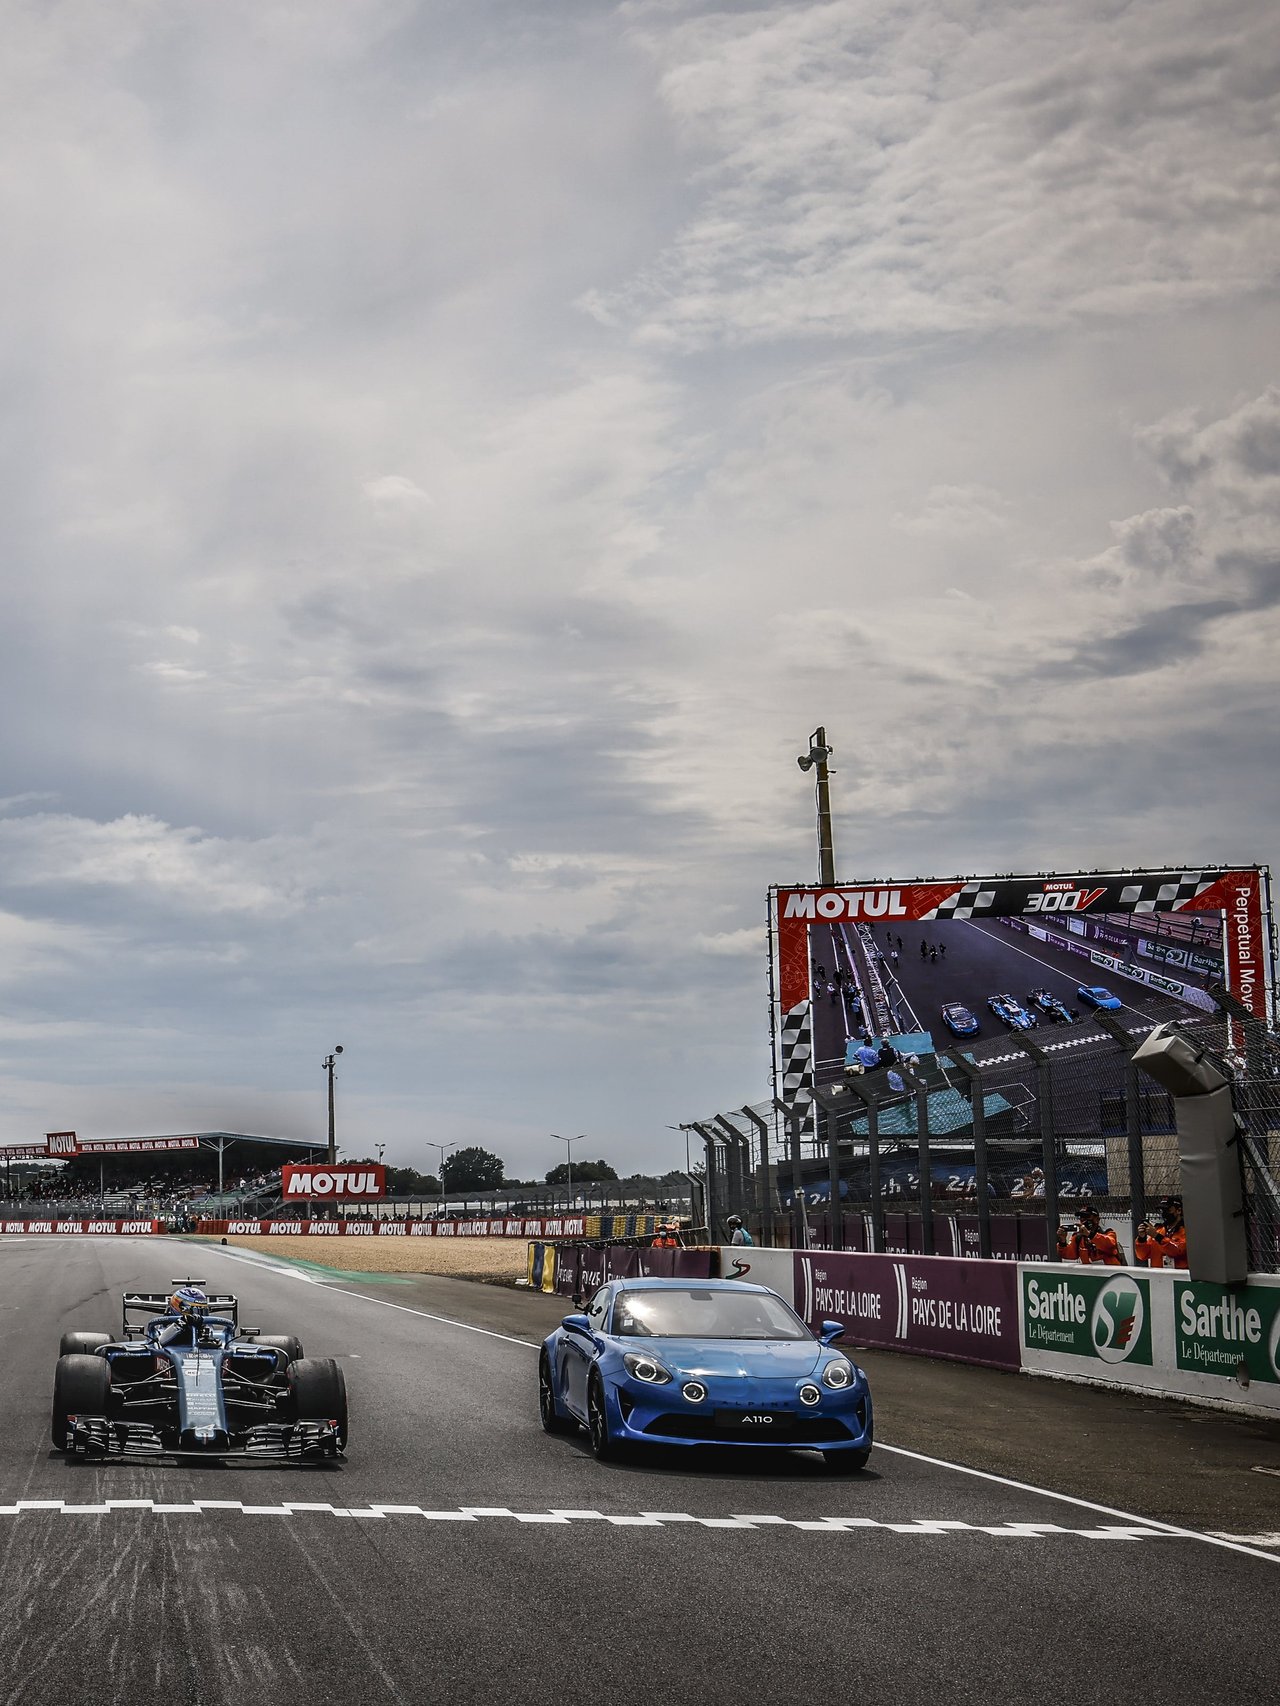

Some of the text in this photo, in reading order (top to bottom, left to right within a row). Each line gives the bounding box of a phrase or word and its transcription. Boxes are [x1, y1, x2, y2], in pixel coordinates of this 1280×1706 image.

[1045, 883, 1074, 891] MOTUL
[783, 891, 907, 918] MOTUL
[1023, 888, 1108, 913] 300V
[1233, 887, 1252, 964] Perpetual
[49, 1135, 77, 1154] MOTUL
[287, 1173, 380, 1194] MOTUL
[28, 1222, 52, 1232] MOTUL
[56, 1222, 82, 1232] MOTUL
[88, 1222, 116, 1232] MOTUL
[122, 1222, 152, 1232] MOTUL
[228, 1223, 261, 1233] MOTUL
[269, 1223, 301, 1233] MOTUL
[309, 1223, 339, 1234] MOTUL
[346, 1223, 373, 1234] MOTUL
[379, 1223, 406, 1235] MOTUL
[411, 1223, 432, 1235] MOTUL
[815, 1287, 881, 1320] PAYS DE LA LOIRE
[1027, 1279, 1086, 1324] Sarthe
[912, 1297, 1002, 1336] PAYS DE LA LOIRE
[1180, 1290, 1262, 1343] Sarthe
[1028, 1323, 1075, 1344] Le Département
[1181, 1340, 1245, 1366] Le Département
[741, 1415, 773, 1424] A110
